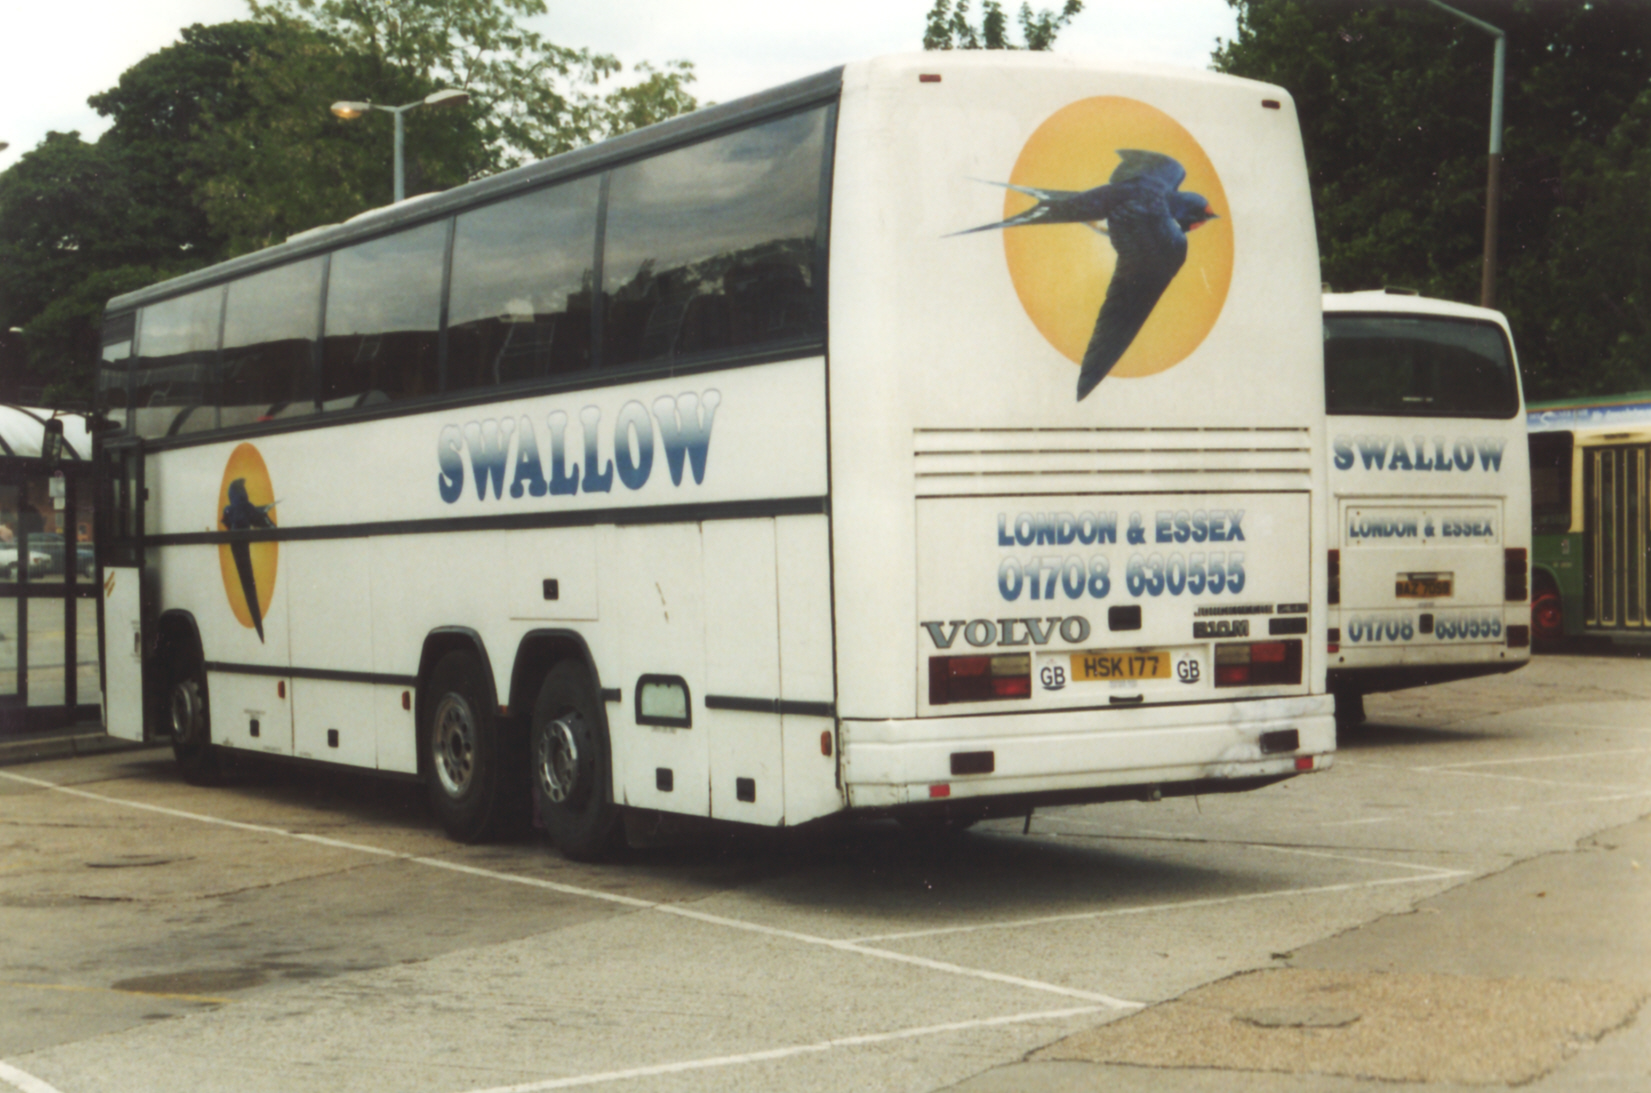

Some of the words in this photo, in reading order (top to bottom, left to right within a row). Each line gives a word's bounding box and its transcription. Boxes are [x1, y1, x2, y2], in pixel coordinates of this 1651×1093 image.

[438, 387, 722, 504] SWALLOW
[1333, 433, 1507, 472] SWALLOW
[997, 511, 1117, 547] LONDON
[1125, 512, 1146, 545] &
[1155, 509, 1246, 543] ESSEX
[1349, 516, 1417, 538] LONDON
[1424, 516, 1435, 538] &
[1442, 516, 1494, 537] ESSEX
[997, 554, 1111, 602] 01708
[1125, 552, 1246, 598] 630555
[921, 615, 1091, 648] VOLVO
[1348, 613, 1414, 642] 01708
[1434, 612, 1502, 640] 630555
[1040, 666, 1065, 686] GB
[1084, 656, 1124, 677] HSK
[1129, 656, 1159, 676] 177
[1177, 659, 1200, 680] GB
